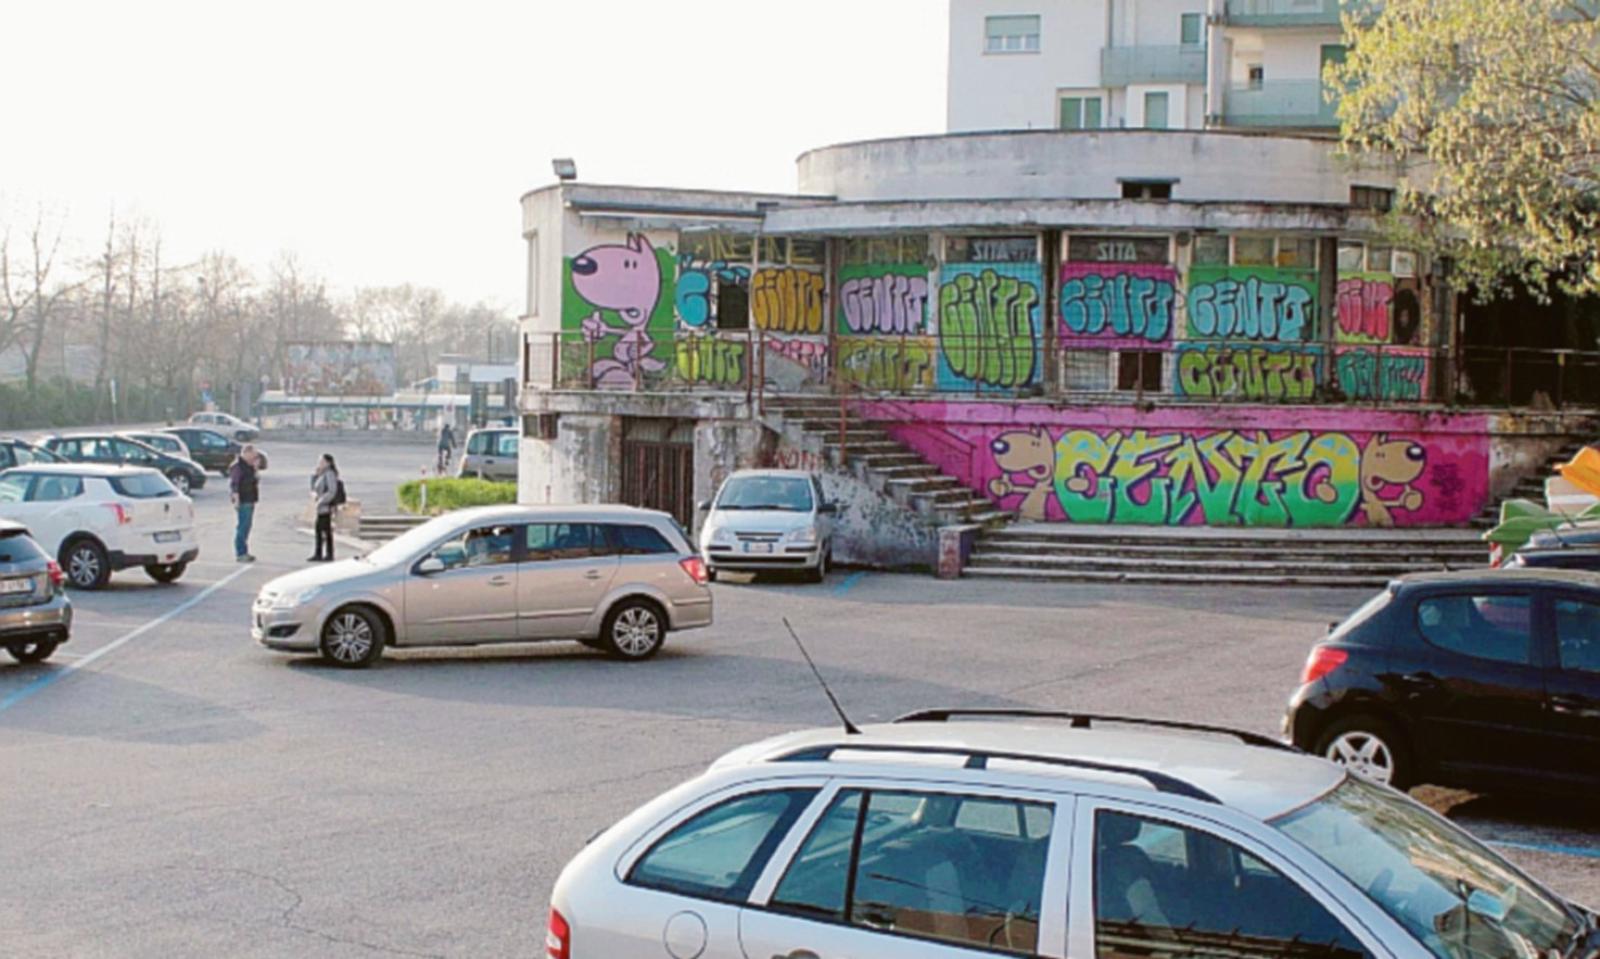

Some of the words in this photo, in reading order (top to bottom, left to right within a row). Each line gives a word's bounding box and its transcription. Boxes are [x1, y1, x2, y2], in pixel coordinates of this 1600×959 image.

[1097, 242, 1136, 261] SITA
[1060, 271, 1176, 342] CENTO
[1187, 276, 1313, 342] CENTO
[1177, 345, 1317, 399] CENTO
[1053, 427, 1361, 528] CENTO
